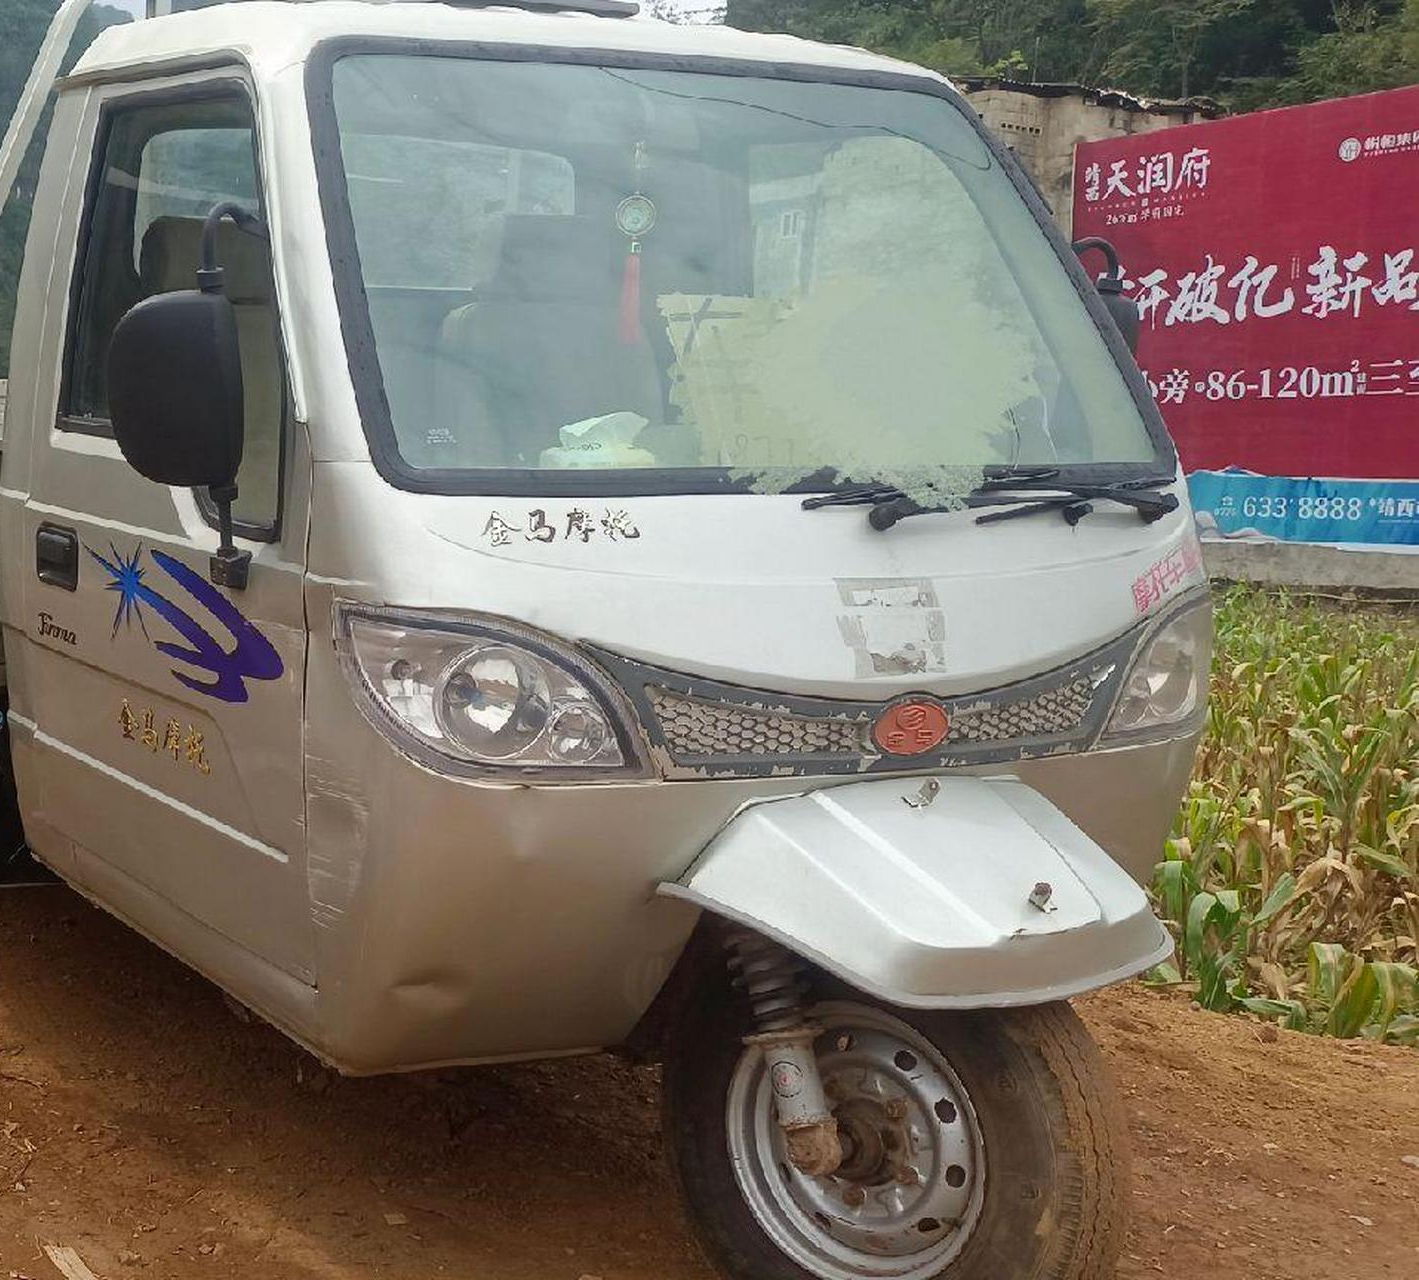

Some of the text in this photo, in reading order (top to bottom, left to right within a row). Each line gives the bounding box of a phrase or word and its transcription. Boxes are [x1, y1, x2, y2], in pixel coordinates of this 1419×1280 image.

[1102, 147, 1211, 200] 天润府
[481, 507, 642, 547] 金马摩托
[1377, 497, 1419, 518] 靖西
